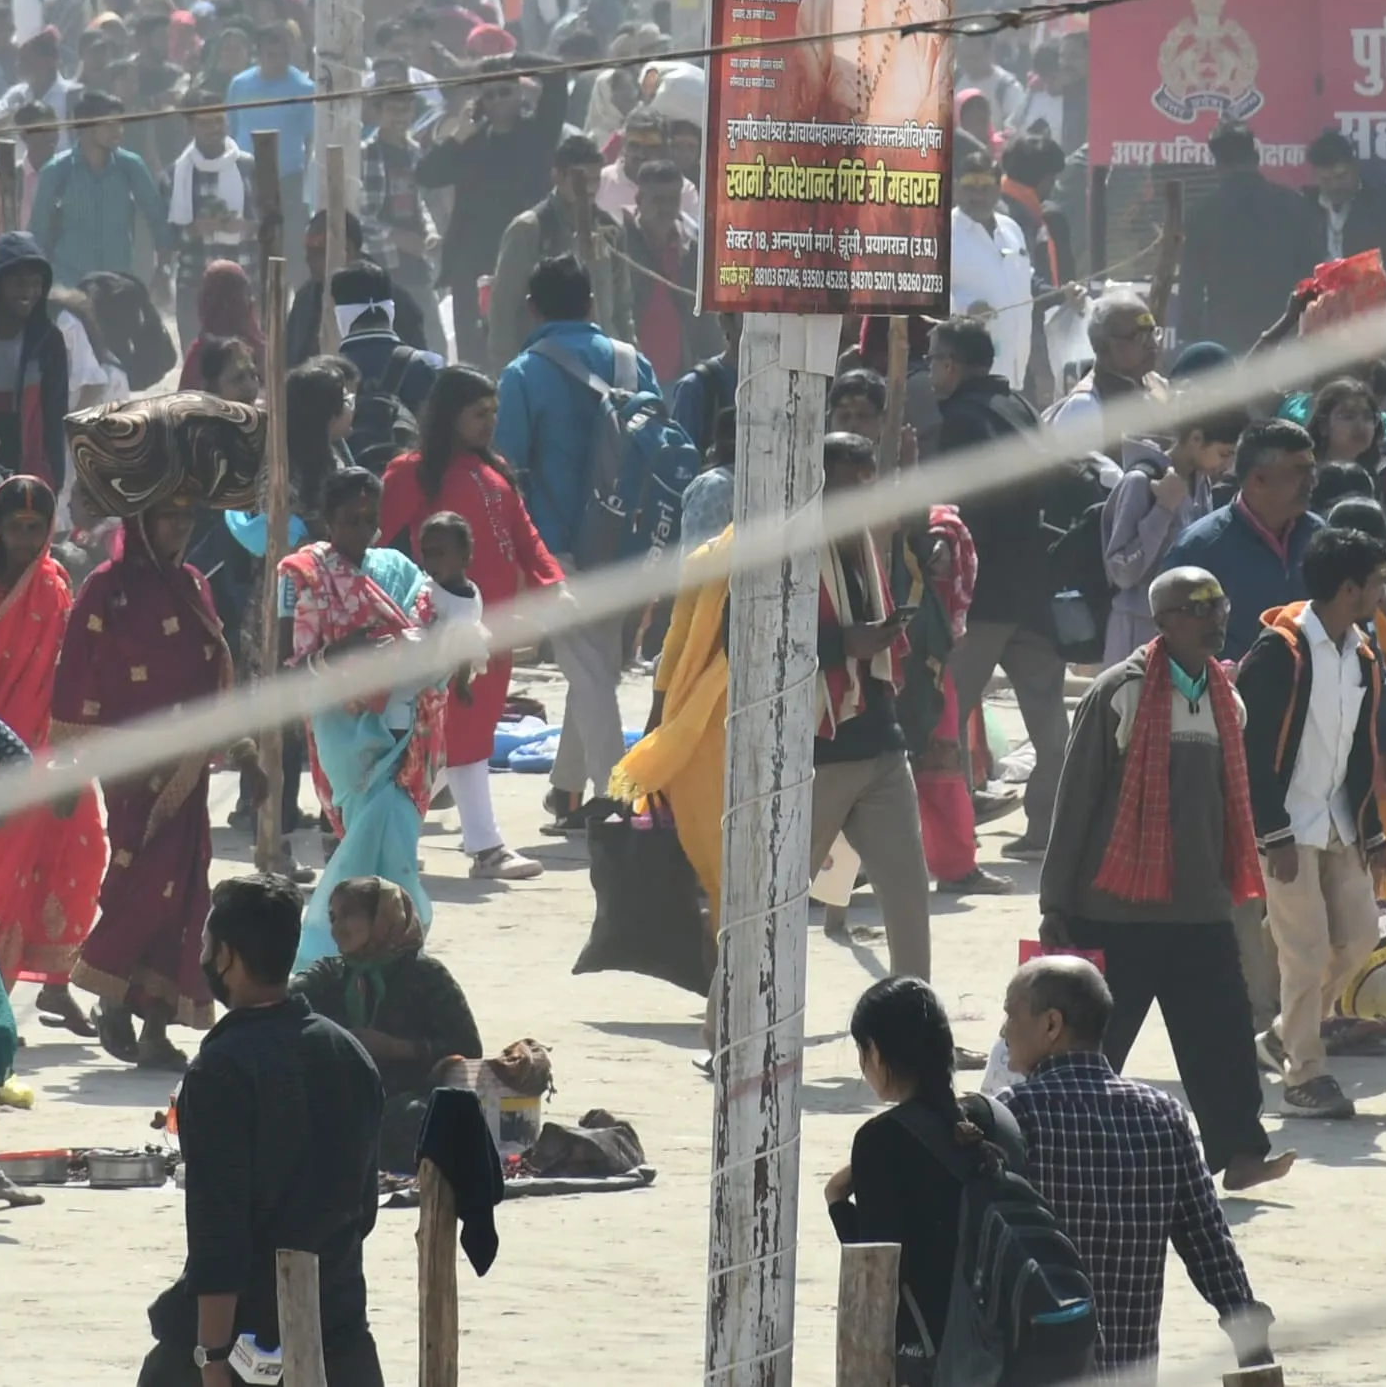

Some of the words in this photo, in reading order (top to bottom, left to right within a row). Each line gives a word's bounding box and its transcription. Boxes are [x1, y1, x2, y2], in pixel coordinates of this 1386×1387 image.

[726, 154, 765, 199] स्वामी
[767, 156, 836, 202] अवधेशानंद
[837, 157, 867, 203] गिरि
[867, 159, 886, 204] जी
[887, 169, 941, 207] महाराज
[726, 224, 753, 251] सेक्टर
[755, 233, 769, 253] 18,
[771, 226, 813, 260] अन्नपूर्णा
[814, 228, 836, 255] मार्ग,
[864, 235, 908, 257] प्रयागराज
[910, 238, 938, 260] (उ.प्र.)
[755, 267, 776, 286] 88103
[802, 269, 826, 288] 93502
[850, 272, 873, 290] 94370
[898, 274, 921, 292] 98260
[922, 275, 943, 293] 22733
